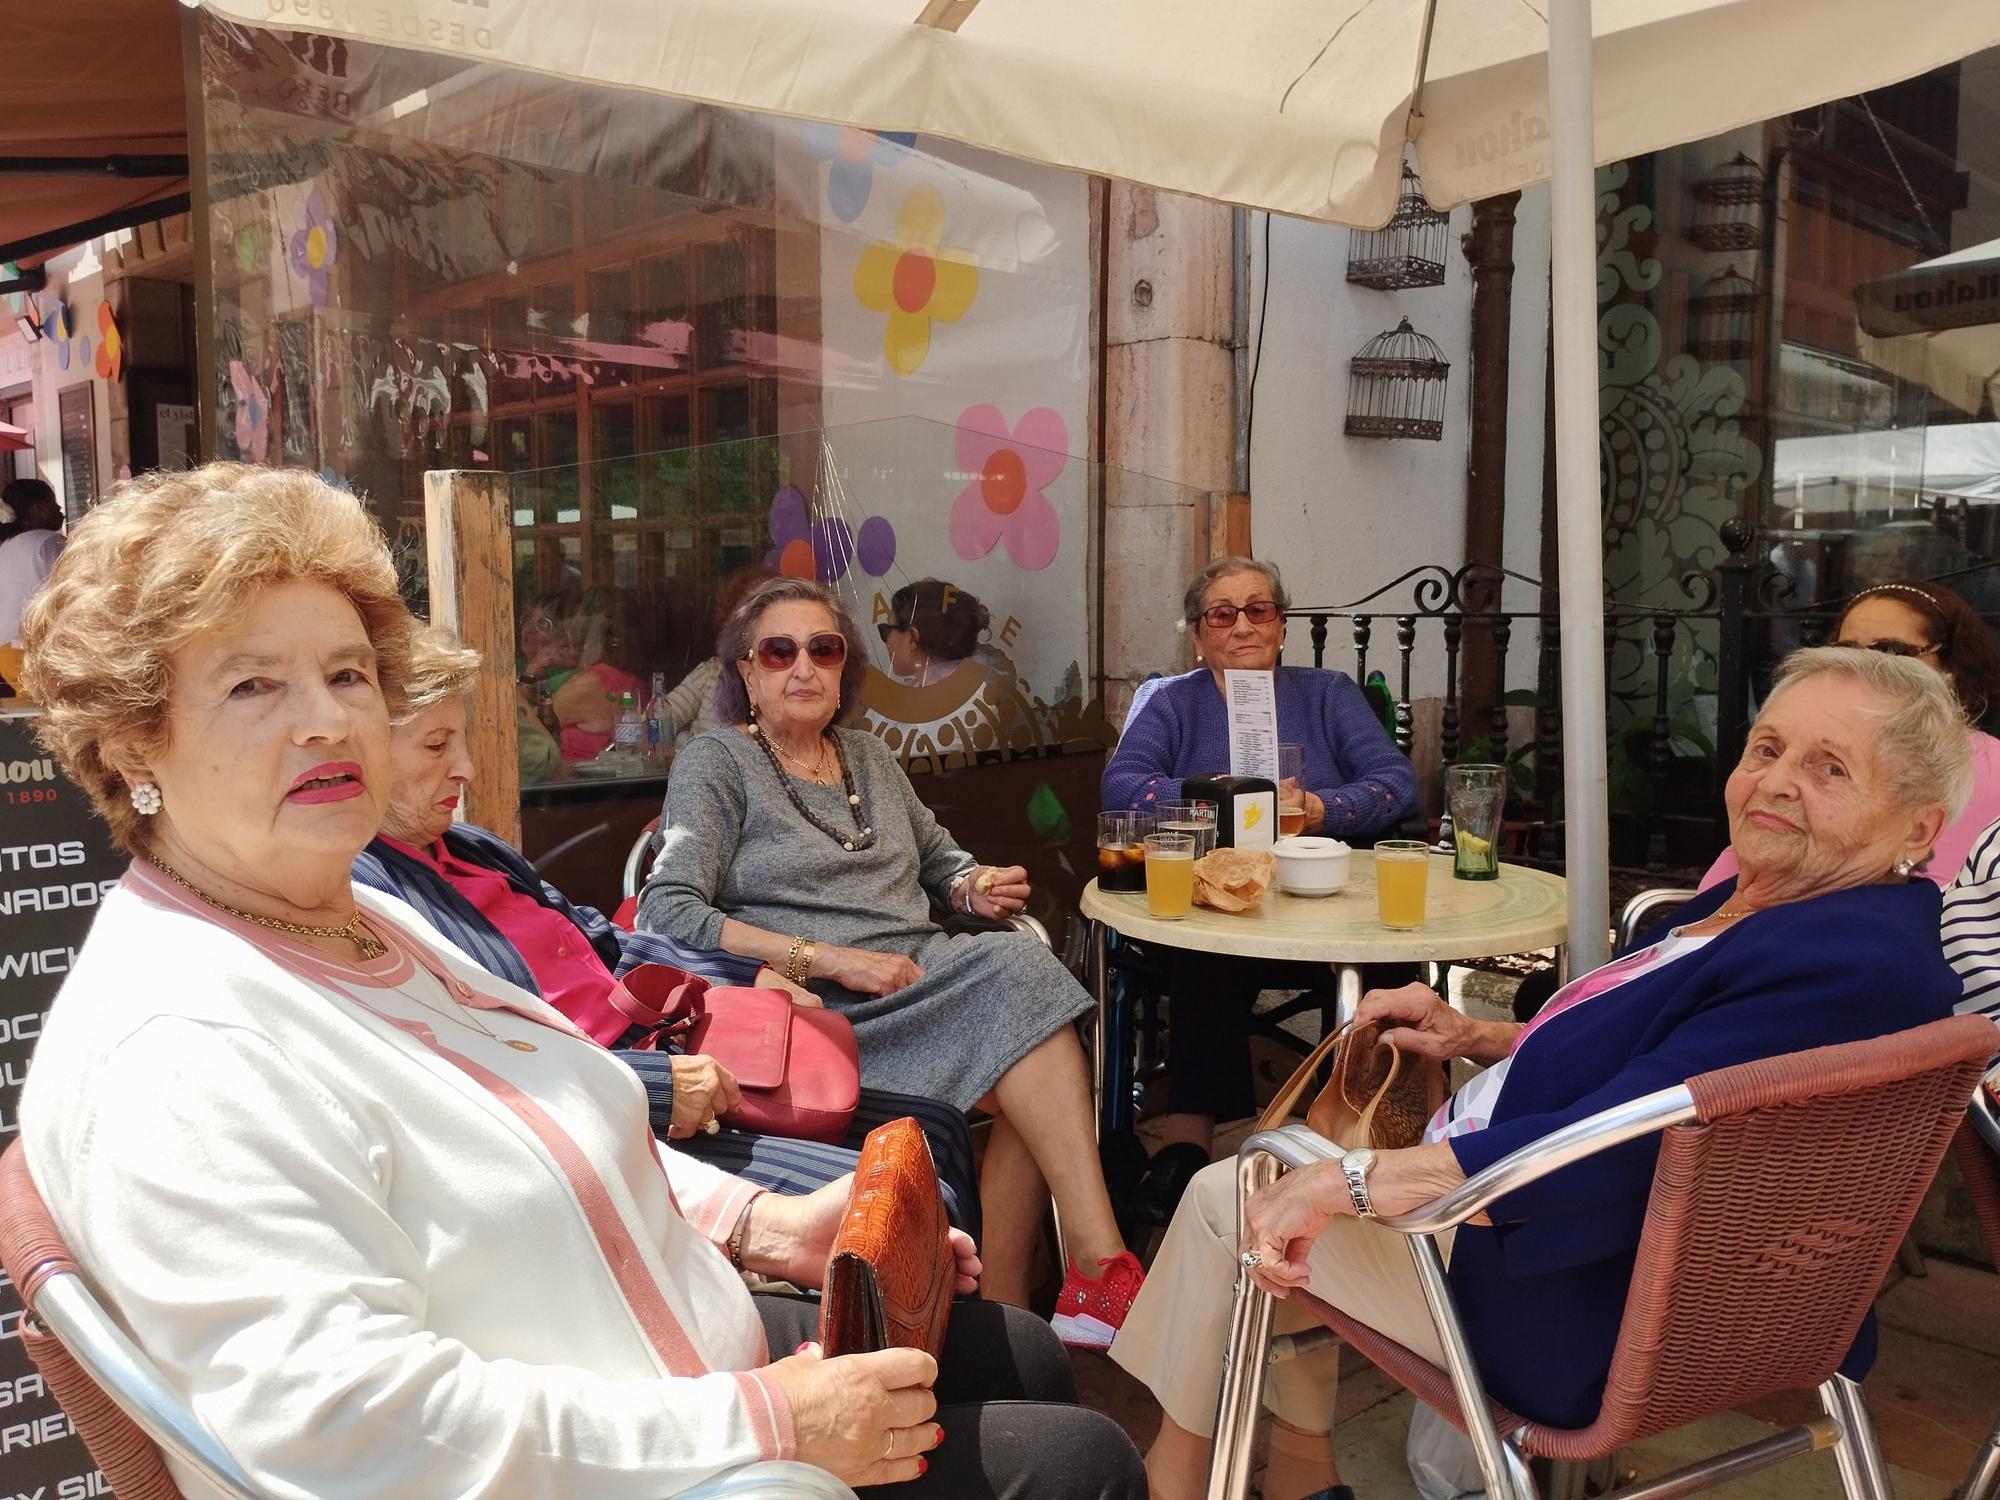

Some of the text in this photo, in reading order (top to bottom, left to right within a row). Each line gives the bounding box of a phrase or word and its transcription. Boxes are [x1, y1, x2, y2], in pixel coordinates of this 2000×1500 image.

[7, 788, 57, 805] 1890
[0, 840, 86, 872] TOS
[0, 1412, 76, 1456] RIE
